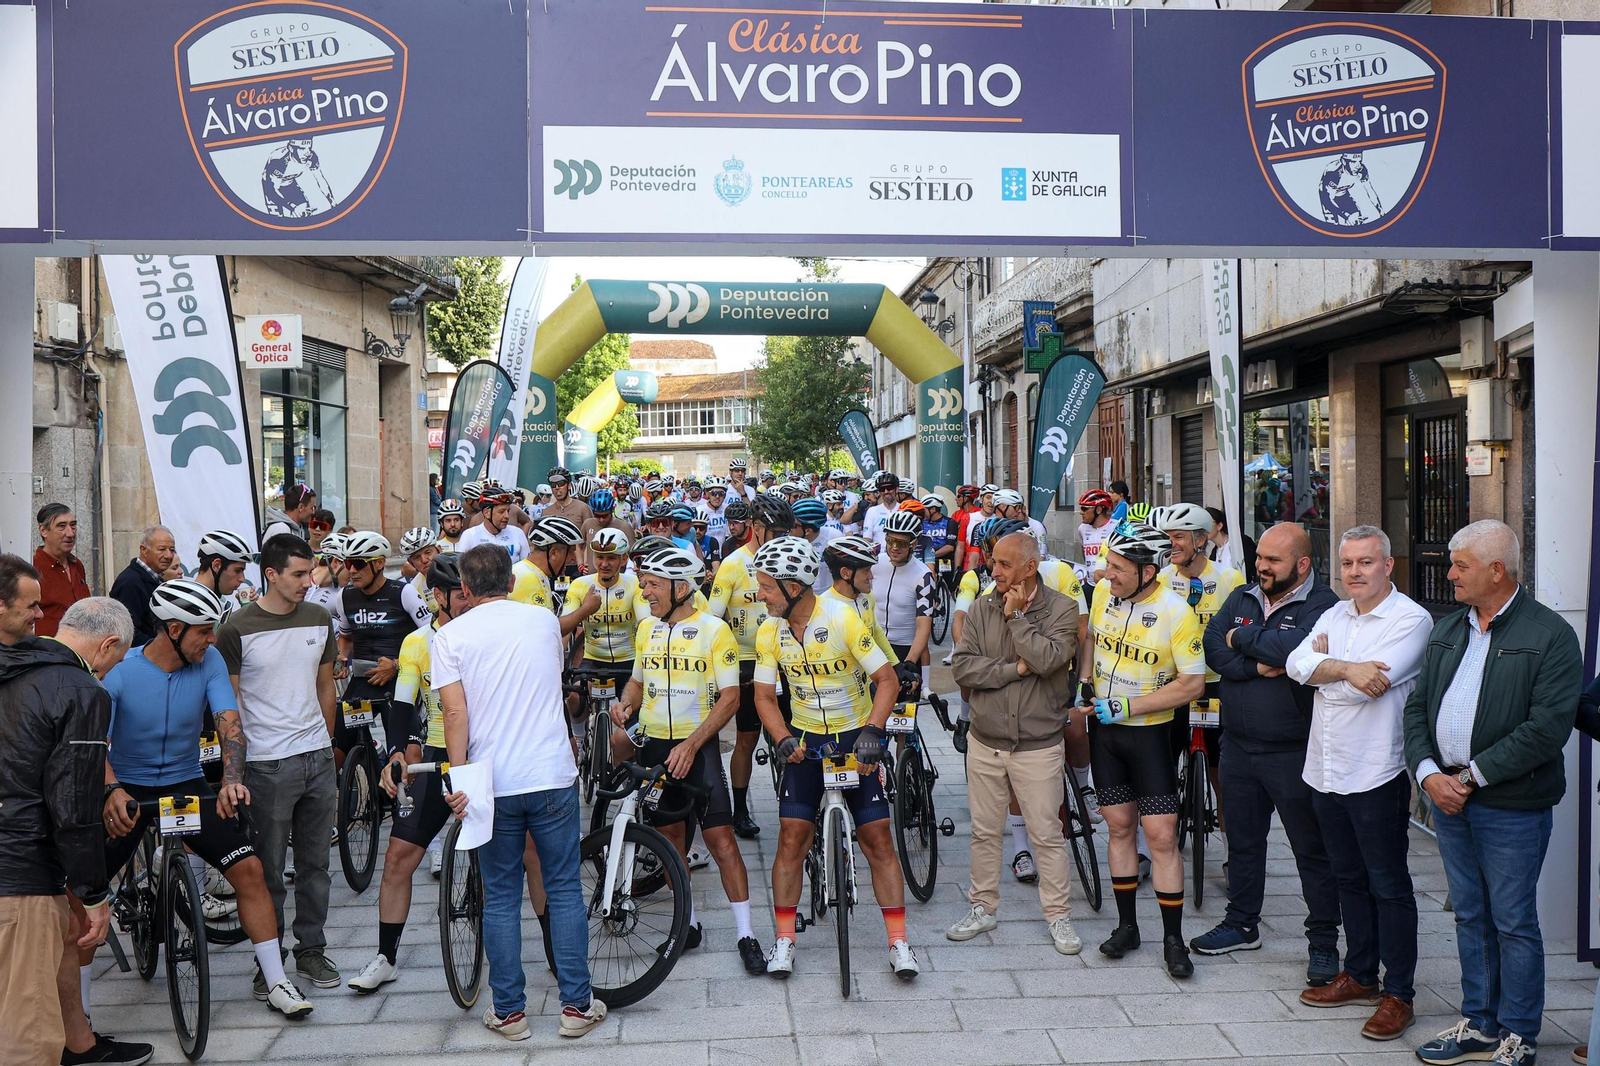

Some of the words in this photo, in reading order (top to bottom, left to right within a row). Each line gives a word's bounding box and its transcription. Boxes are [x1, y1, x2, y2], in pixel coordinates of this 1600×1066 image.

[250, 22, 310, 39] GRUPO
[728, 18, 863, 54] Clásica
[1309, 43, 1363, 58] GRUPO
[235, 87, 304, 108] Clásica
[1295, 104, 1356, 123] Clásica
[609, 165, 696, 179] Deputación
[890, 164, 948, 174] GRUPO
[761, 176, 853, 189] PONTEAREAS
[1032, 170, 1079, 183] XUNTA
[609, 179, 696, 192] Pontevedra
[1032, 184, 1050, 196] DE
[1051, 185, 1107, 197] GALICIA
[761, 190, 808, 199] CONCELLO
[719, 287, 830, 304] Deputación
[719, 304, 830, 321] Pontevedra
[251, 343, 292, 353] General
[506, 307, 522, 377] putación
[254, 352, 289, 364] Optica
[1057, 367, 1088, 423] Deputación
[1064, 371, 1096, 427] Pontevedra
[473, 381, 503, 440] Pontevedra
[522, 421, 557, 431] tación
[918, 423, 963, 434] Deputaci
[521, 432, 557, 443] evedra
[62, 467, 70, 478] 11
[353, 608, 388, 624] diez
[587, 611, 633, 624] ESTELO
[1093, 629, 1159, 666] ESTELO
[350, 713, 366, 722] 94
[892, 717, 908, 726] 90
[203, 746, 215, 756] 93
[835, 772, 848, 782] 18
[175, 815, 186, 827] 2
